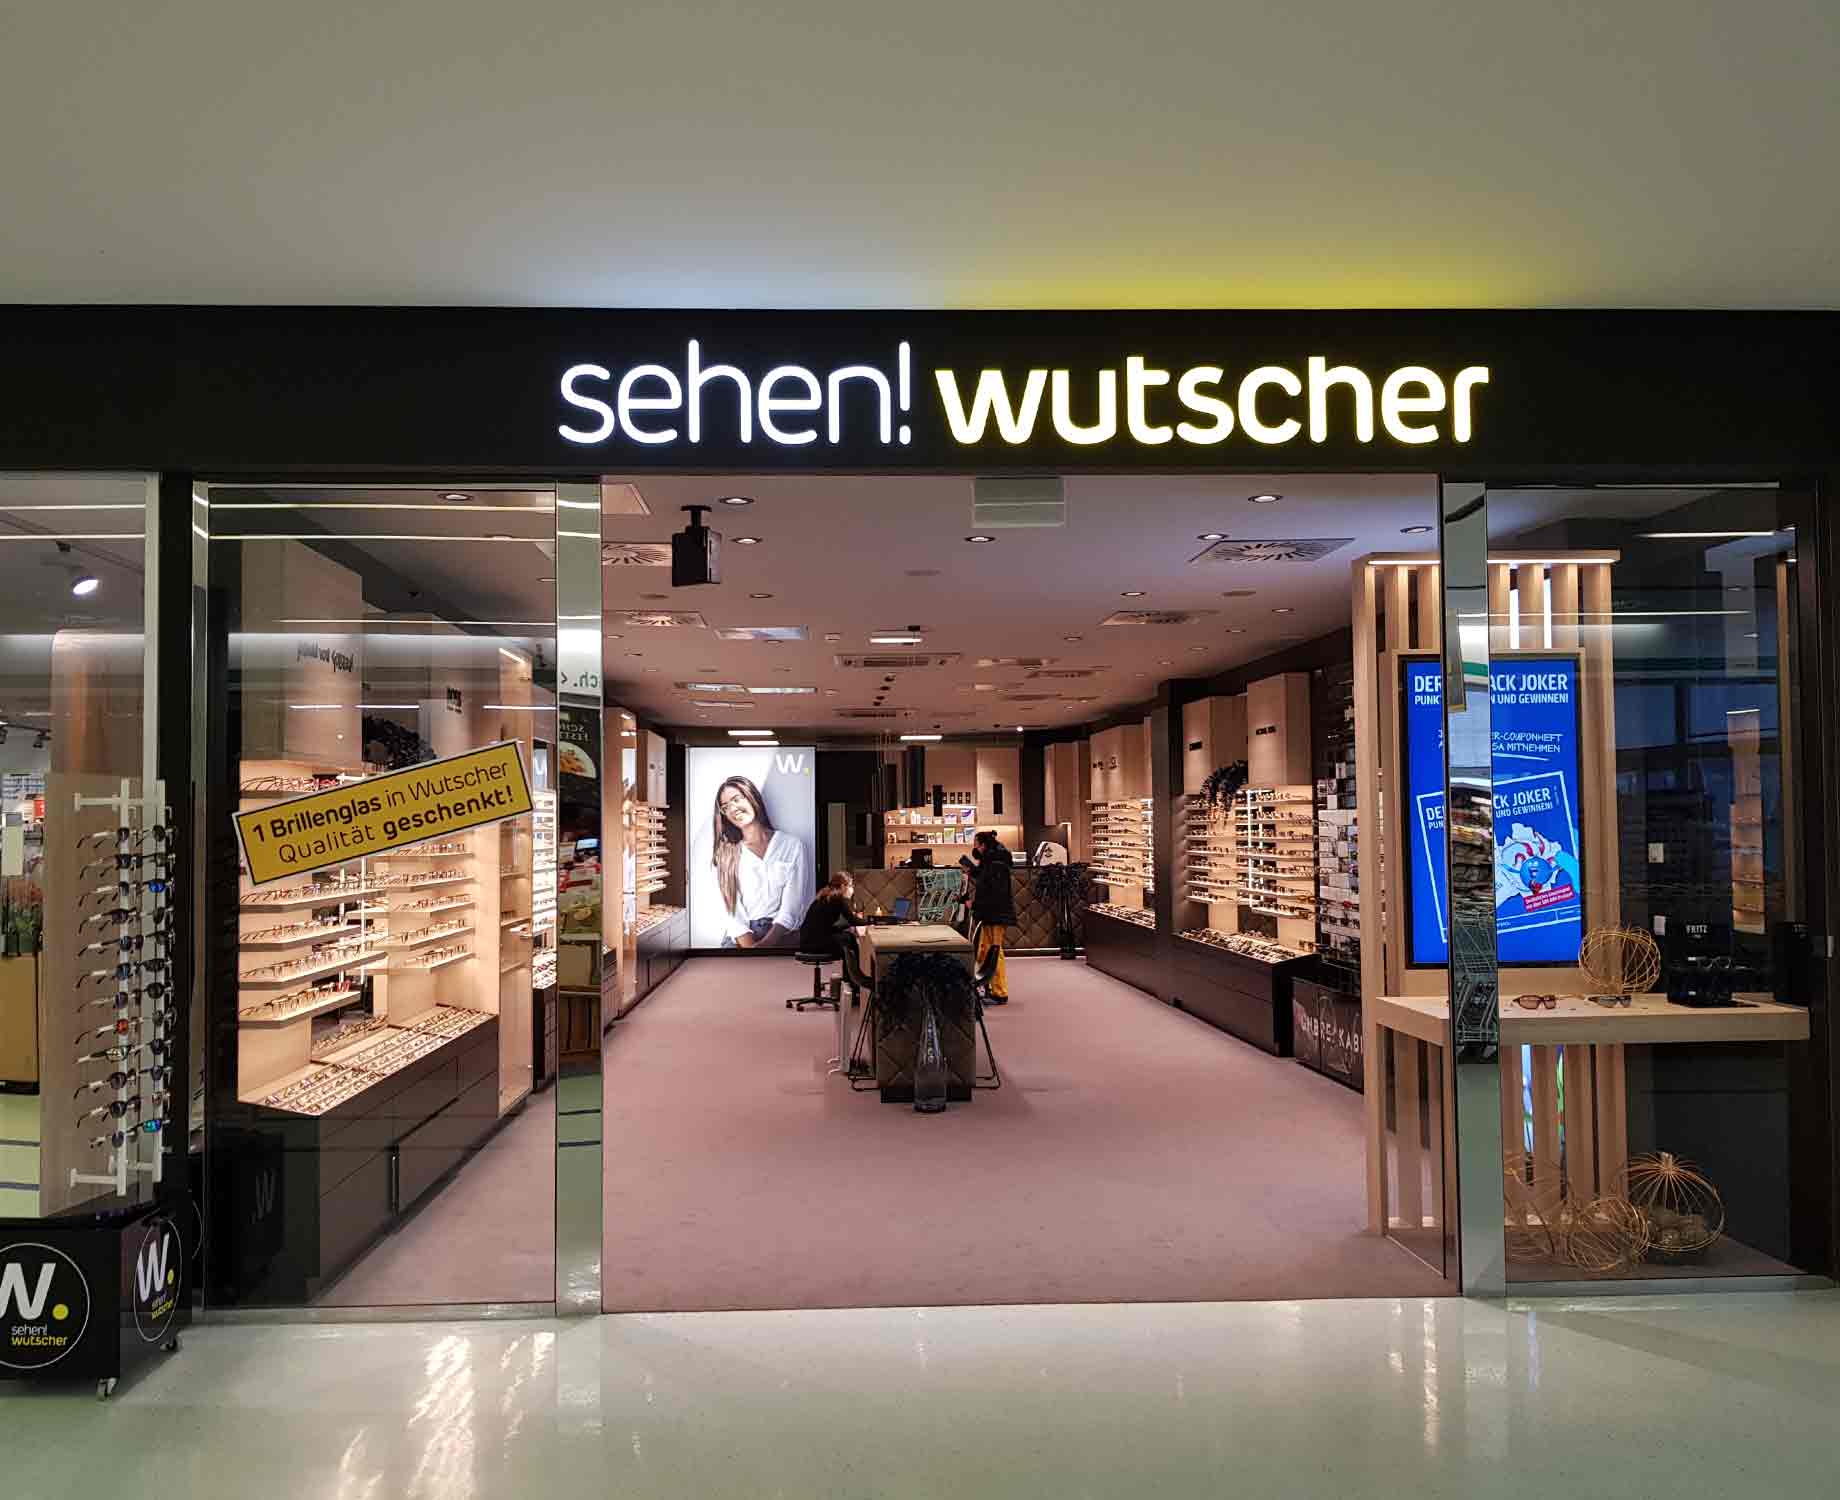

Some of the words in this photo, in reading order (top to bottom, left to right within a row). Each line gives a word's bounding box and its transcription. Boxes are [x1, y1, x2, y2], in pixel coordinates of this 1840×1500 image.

[558, 340, 912, 445] sehen!
[934, 356, 1491, 445] wutscher
[1519, 673, 1569, 692] JOKER
[1414, 694, 1442, 705] PUNK
[1497, 694, 1517, 705] UND
[1493, 731, 1561, 742] R-COUPONHEFT
[1506, 742, 1561, 753] MITNEHMEN
[252, 825, 265, 842] 1
[270, 795, 383, 839] Brillenglas
[383, 788, 407, 809] in
[407, 761, 510, 800] Wutscher
[1512, 787, 1552, 807] JOKER
[278, 824, 376, 864] Qualität
[382, 785, 515, 841] geschenkt!
[11, 1324, 48, 1336] sehen!
[11, 1335, 68, 1347] wutscher
